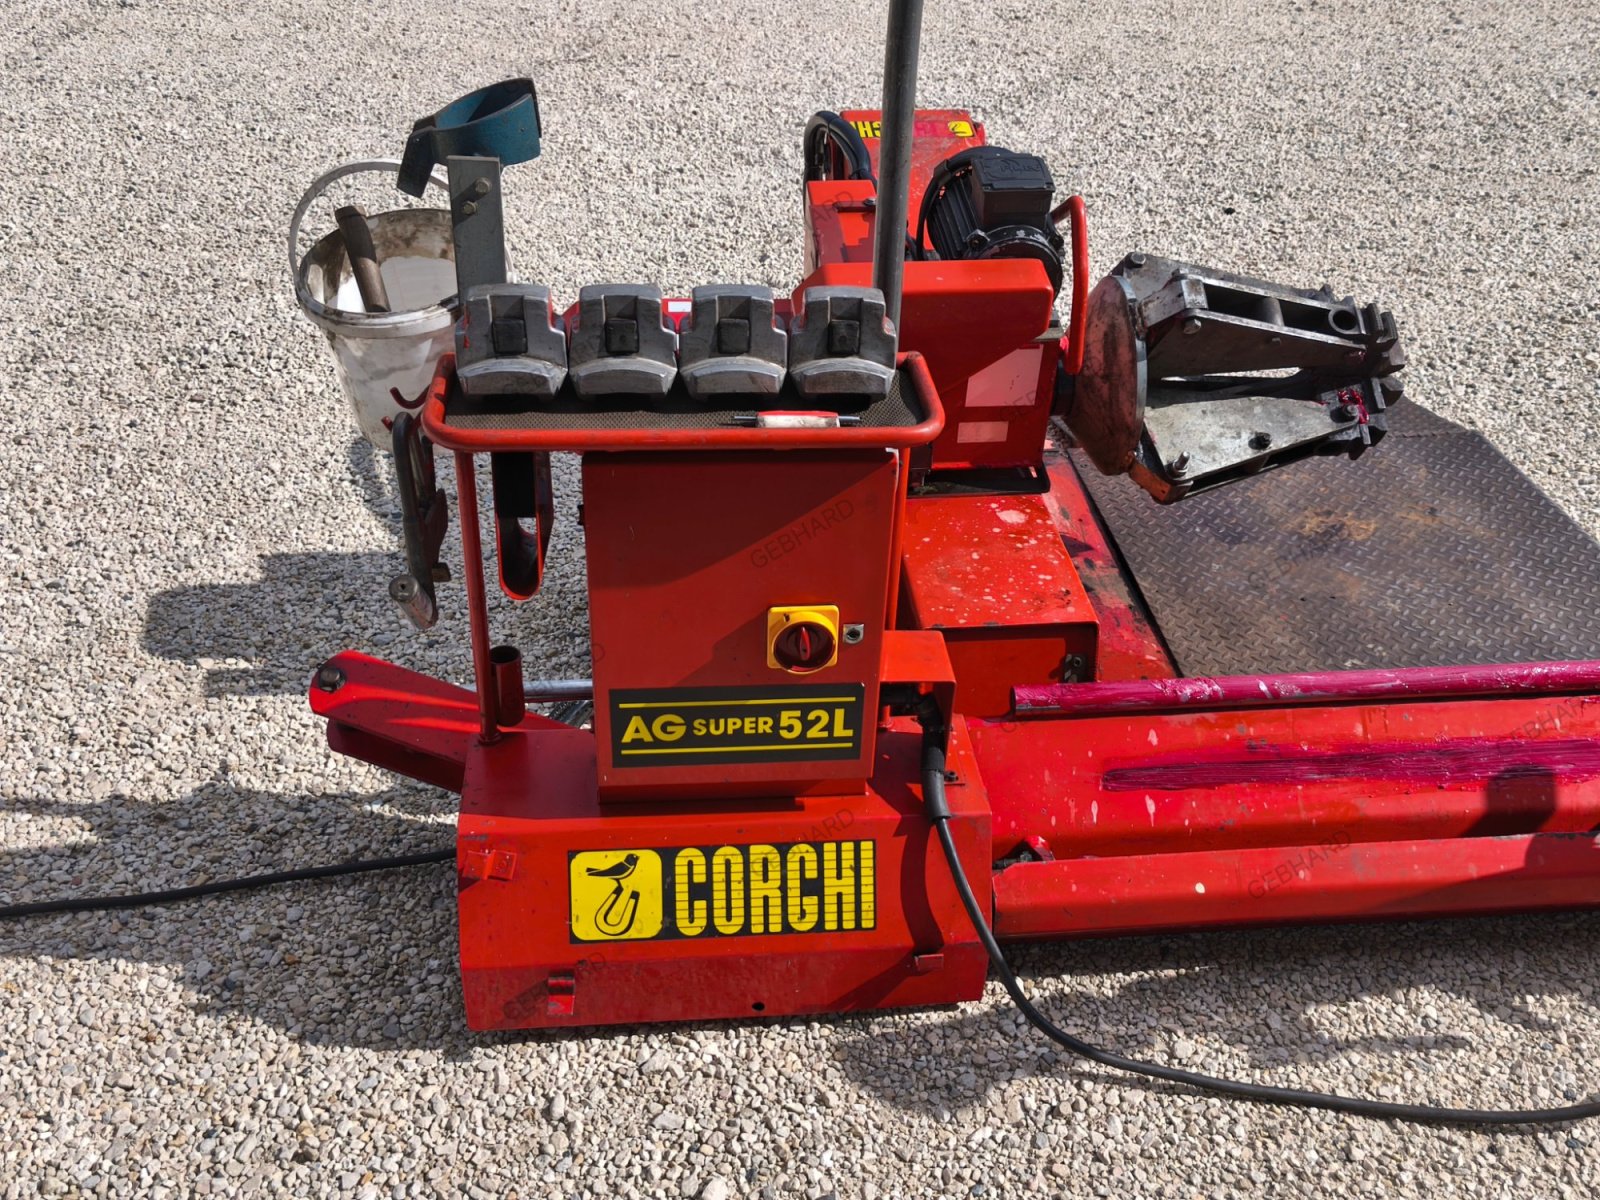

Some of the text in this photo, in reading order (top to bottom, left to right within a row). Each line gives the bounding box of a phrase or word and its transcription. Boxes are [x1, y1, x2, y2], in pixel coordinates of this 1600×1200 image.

[621, 708, 854, 743] AG SUPER 52L
